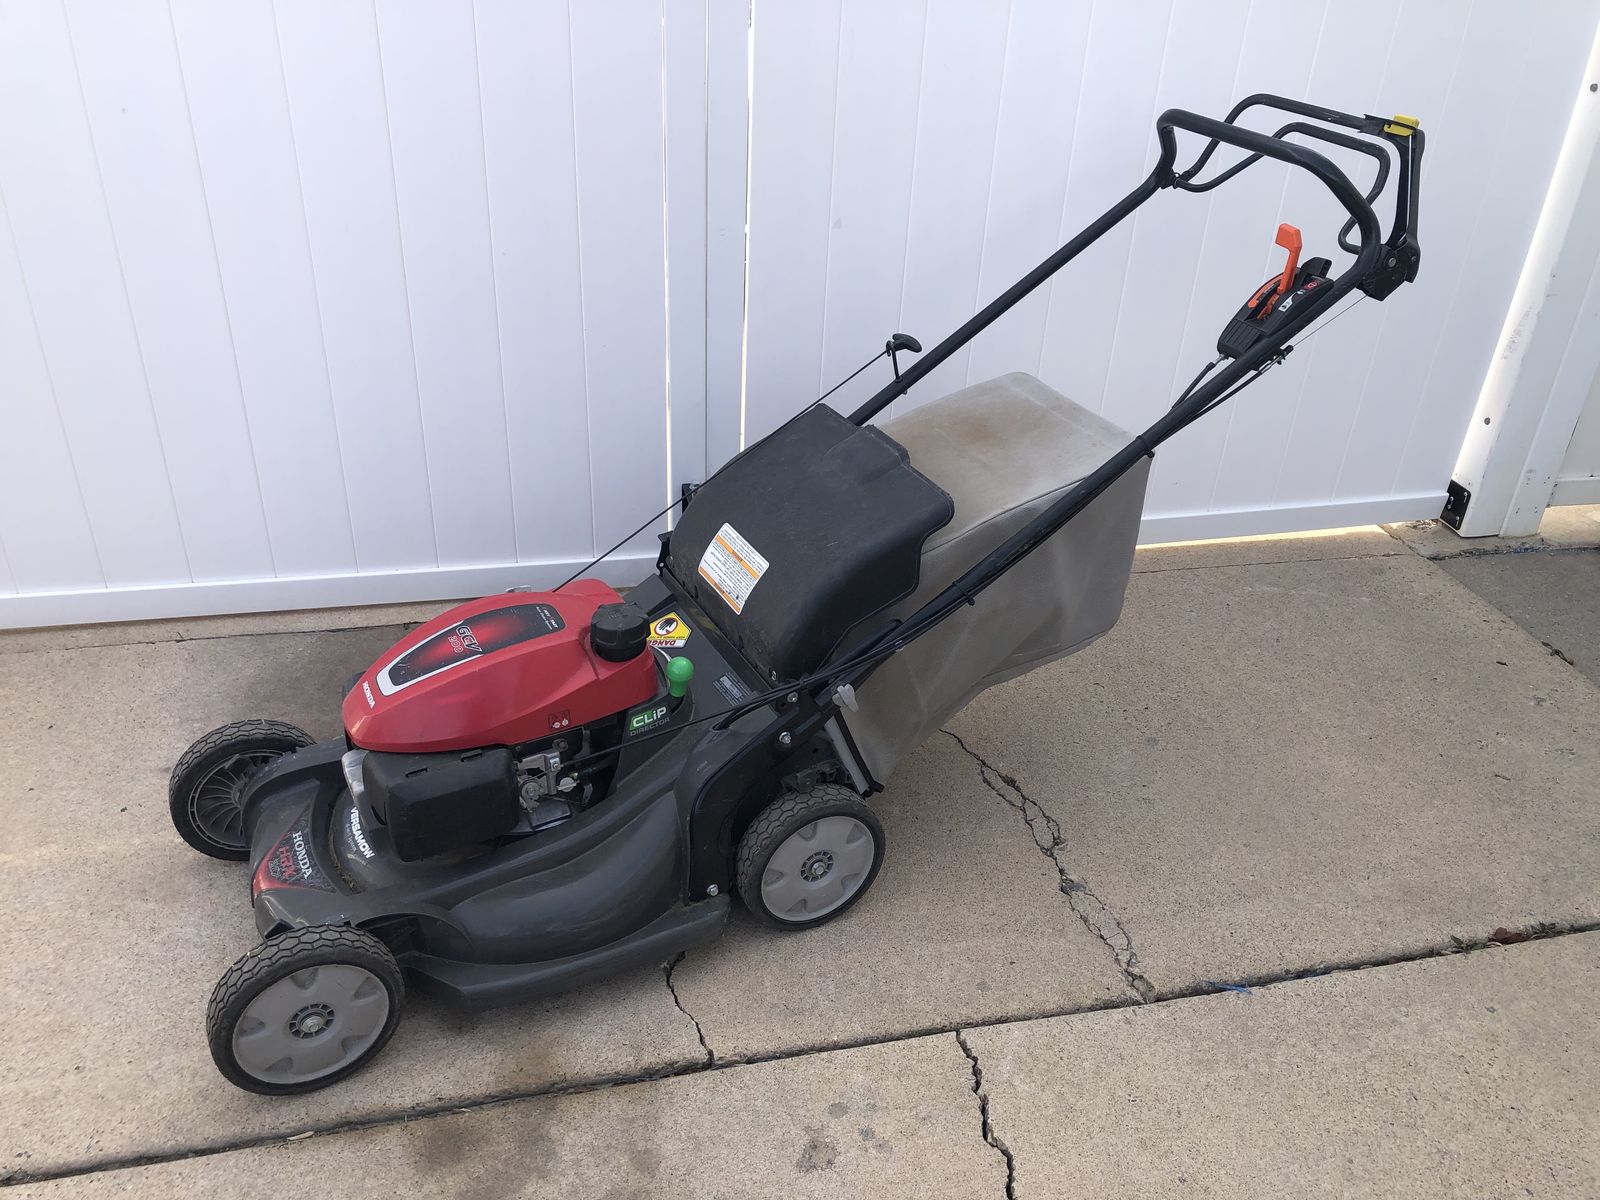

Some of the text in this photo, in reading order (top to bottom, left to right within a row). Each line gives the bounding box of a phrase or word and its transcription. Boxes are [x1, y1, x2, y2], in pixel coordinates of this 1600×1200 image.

[456, 626, 482, 652] GCV
[362, 681, 376, 708] HONDA
[630, 717, 670, 736] DIRECTOR
[350, 807, 375, 858] VERSAMOW
[293, 830, 312, 879] HONDA
